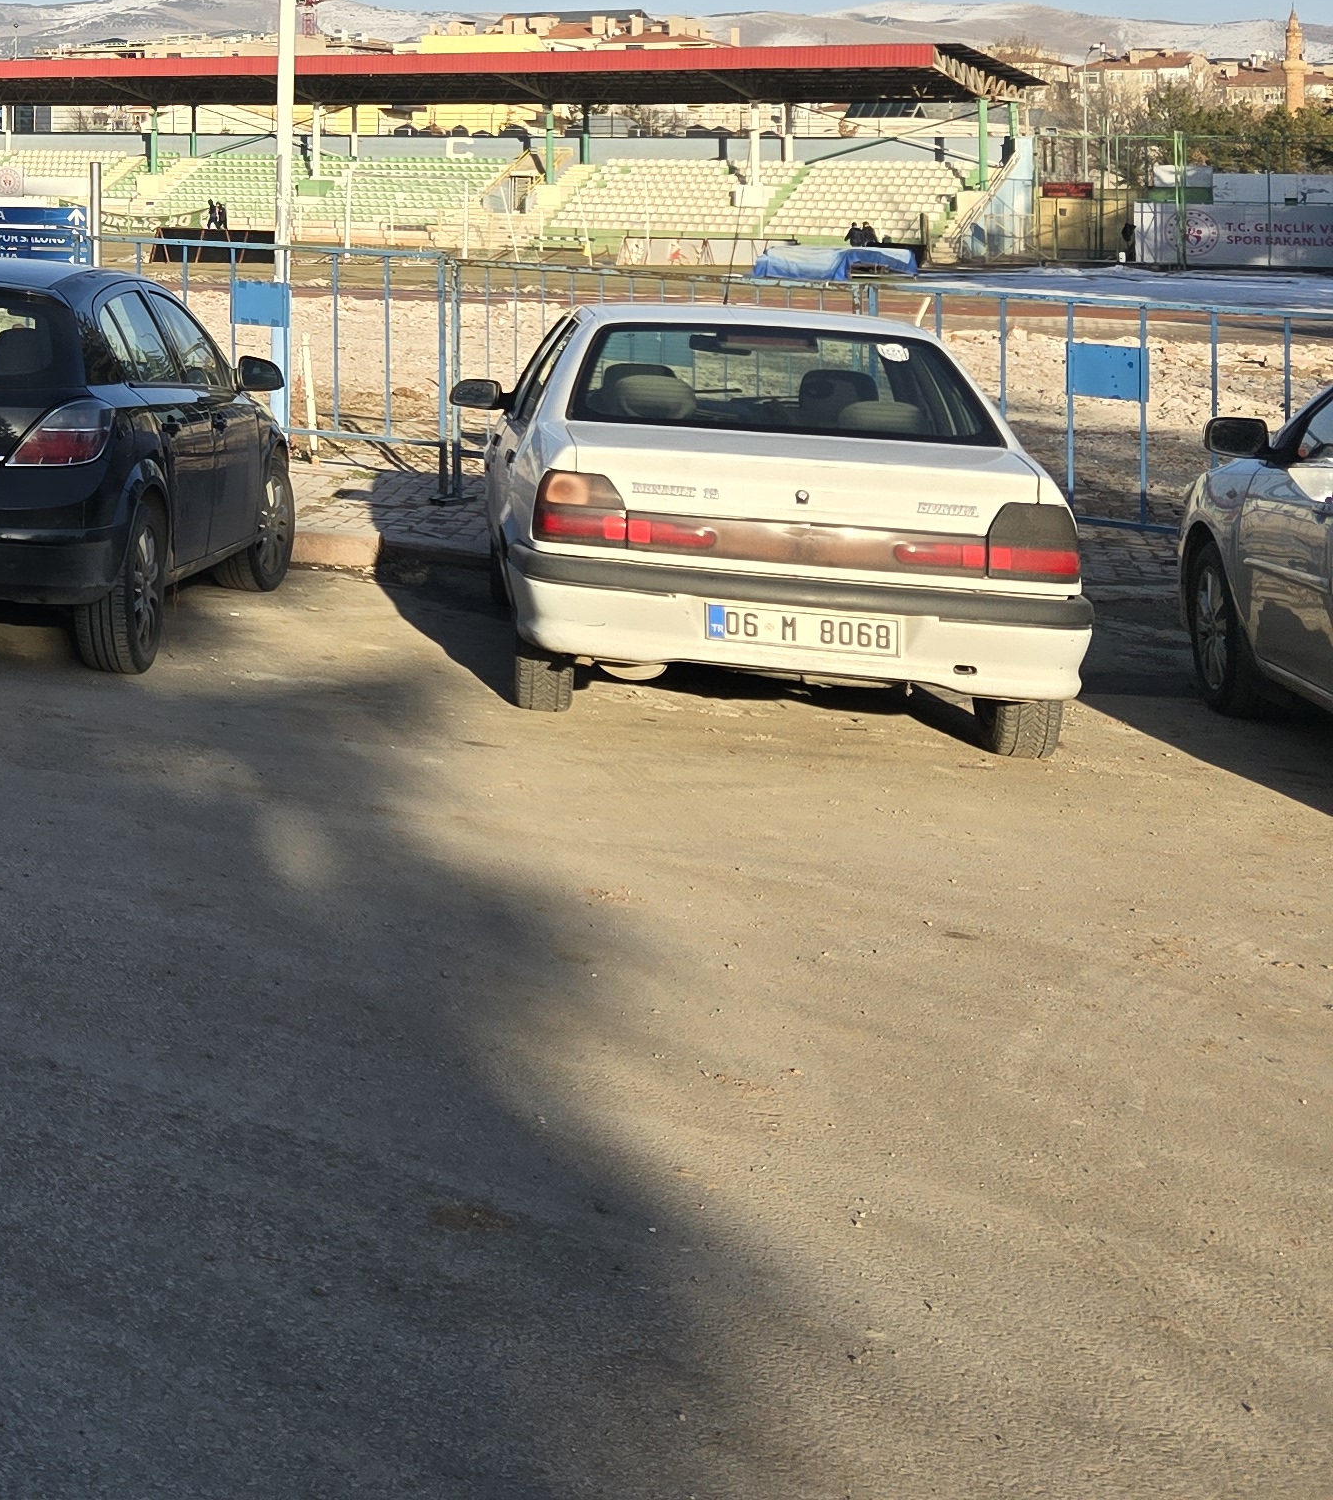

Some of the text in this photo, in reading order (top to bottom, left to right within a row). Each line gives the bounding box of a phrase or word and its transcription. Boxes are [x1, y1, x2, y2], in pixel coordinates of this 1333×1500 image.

[446, 137, 475, 160] C
[1226, 222, 1251, 233] T.C.
[1254, 221, 1315, 234] GENÇLİK
[1226, 235, 1262, 246] SPOR
[631, 481, 720, 500] RENAULT 19
[916, 501, 980, 518] EUROPA
[710, 611, 891, 650] TR 06 M 8068
